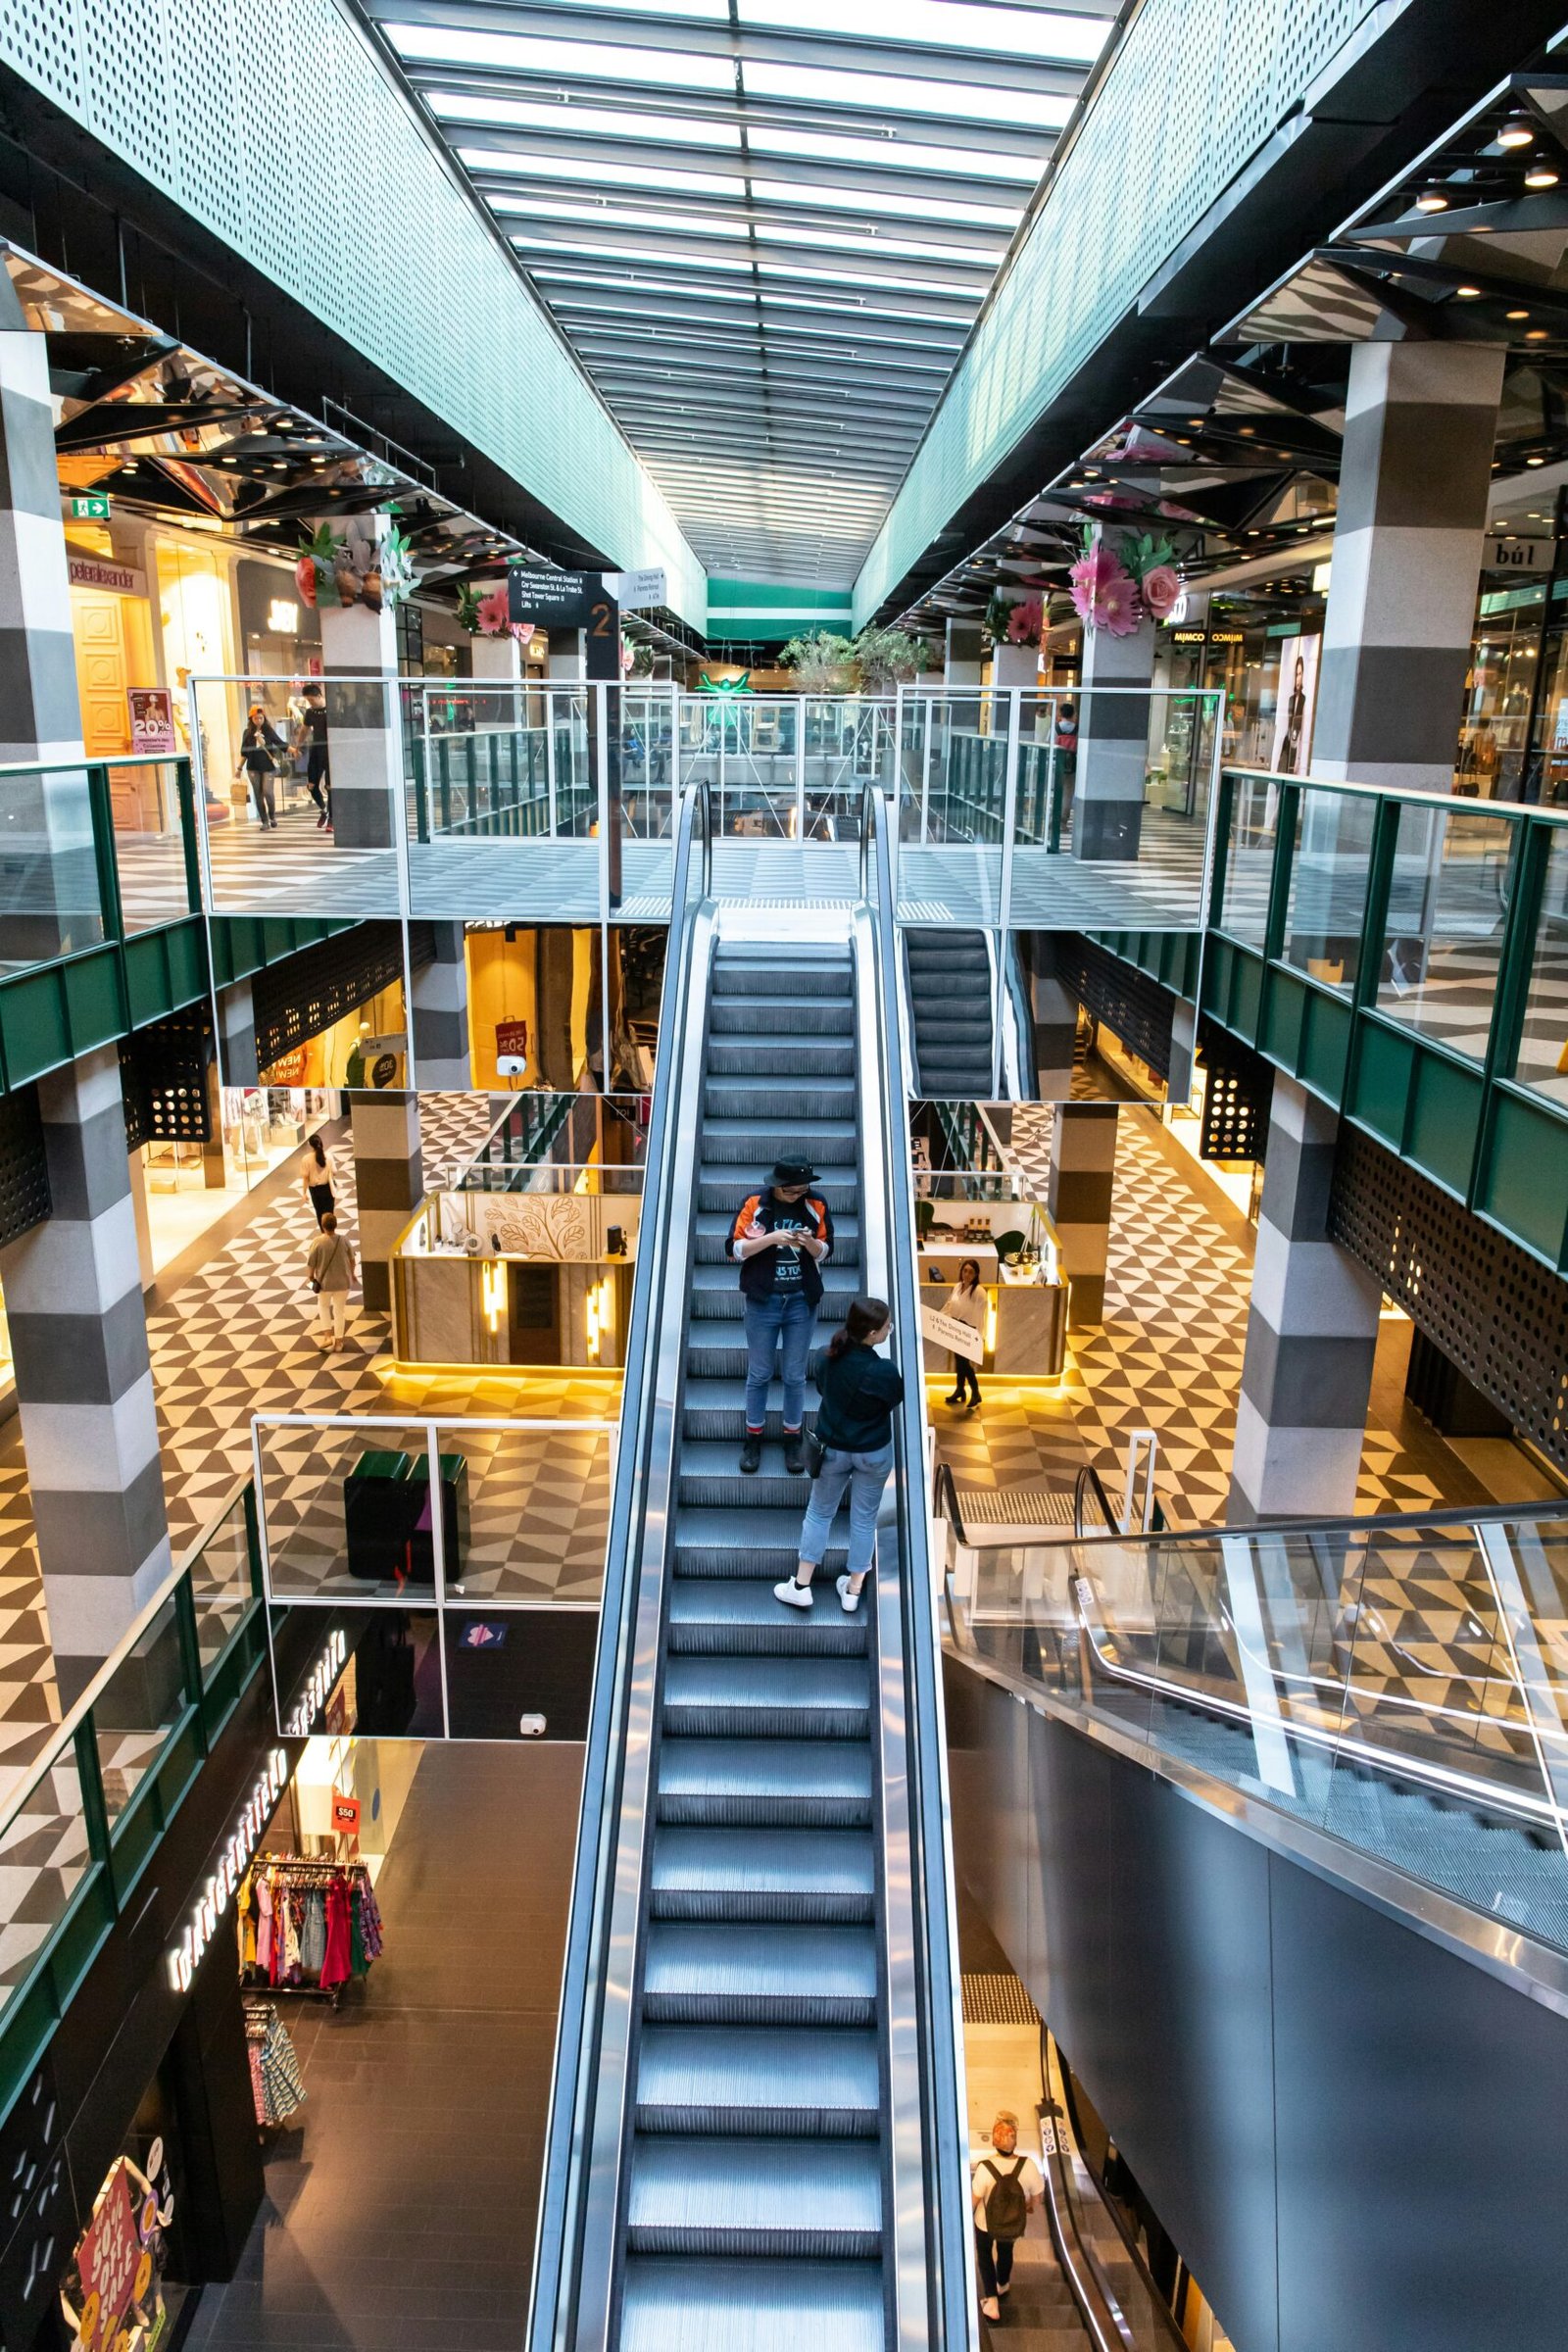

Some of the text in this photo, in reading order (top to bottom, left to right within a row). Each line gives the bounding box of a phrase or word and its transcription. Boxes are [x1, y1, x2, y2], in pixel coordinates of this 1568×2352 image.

[1495, 544, 1535, 565] búl
[520, 570, 579, 584] Melbourne Central Station
[530, 581, 550, 590] Swanston
[521, 590, 560, 602] Shot Tower Square
[591, 603, 611, 636] 2
[1174, 633, 1205, 643] MIMCO
[134, 720, 171, 736] 20%
[938, 1326, 971, 1348] Parents Retreat
[948, 1323, 962, 1335] Dining
[962, 1330, 971, 1339] Hall
[338, 1807, 354, 1818] $50
[100, 2224, 123, 2297] OFF
[100, 2239, 132, 2334] SALE
